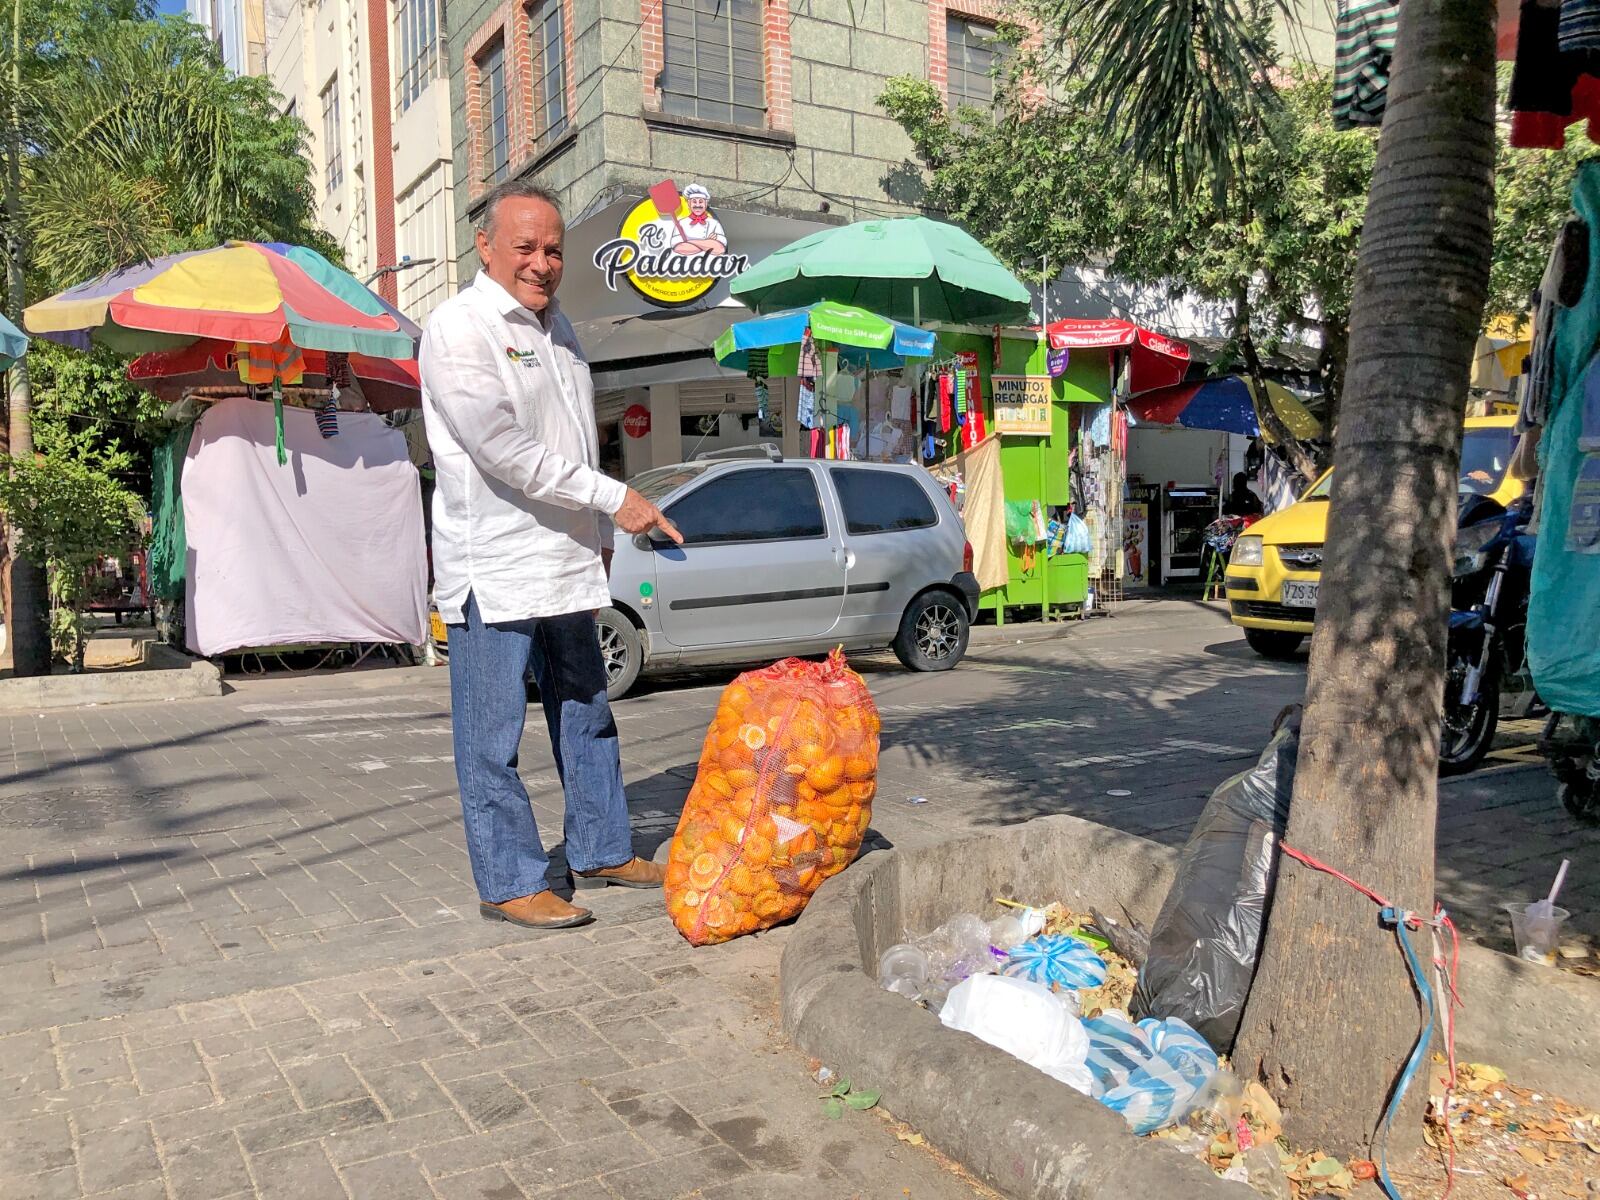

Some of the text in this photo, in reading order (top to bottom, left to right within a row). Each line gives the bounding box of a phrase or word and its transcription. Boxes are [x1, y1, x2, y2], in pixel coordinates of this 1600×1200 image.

[639, 224, 664, 249] Al
[594, 239, 748, 291] Paladar
[817, 322, 843, 334] Compra
[853, 328, 868, 337] SIM
[1064, 322, 1111, 330] Claro
[1149, 338, 1171, 354] Claro
[998, 381, 1044, 391] MINUTOS
[994, 393, 1048, 404] RECARGAS
[1284, 583, 1305, 599] VZS
